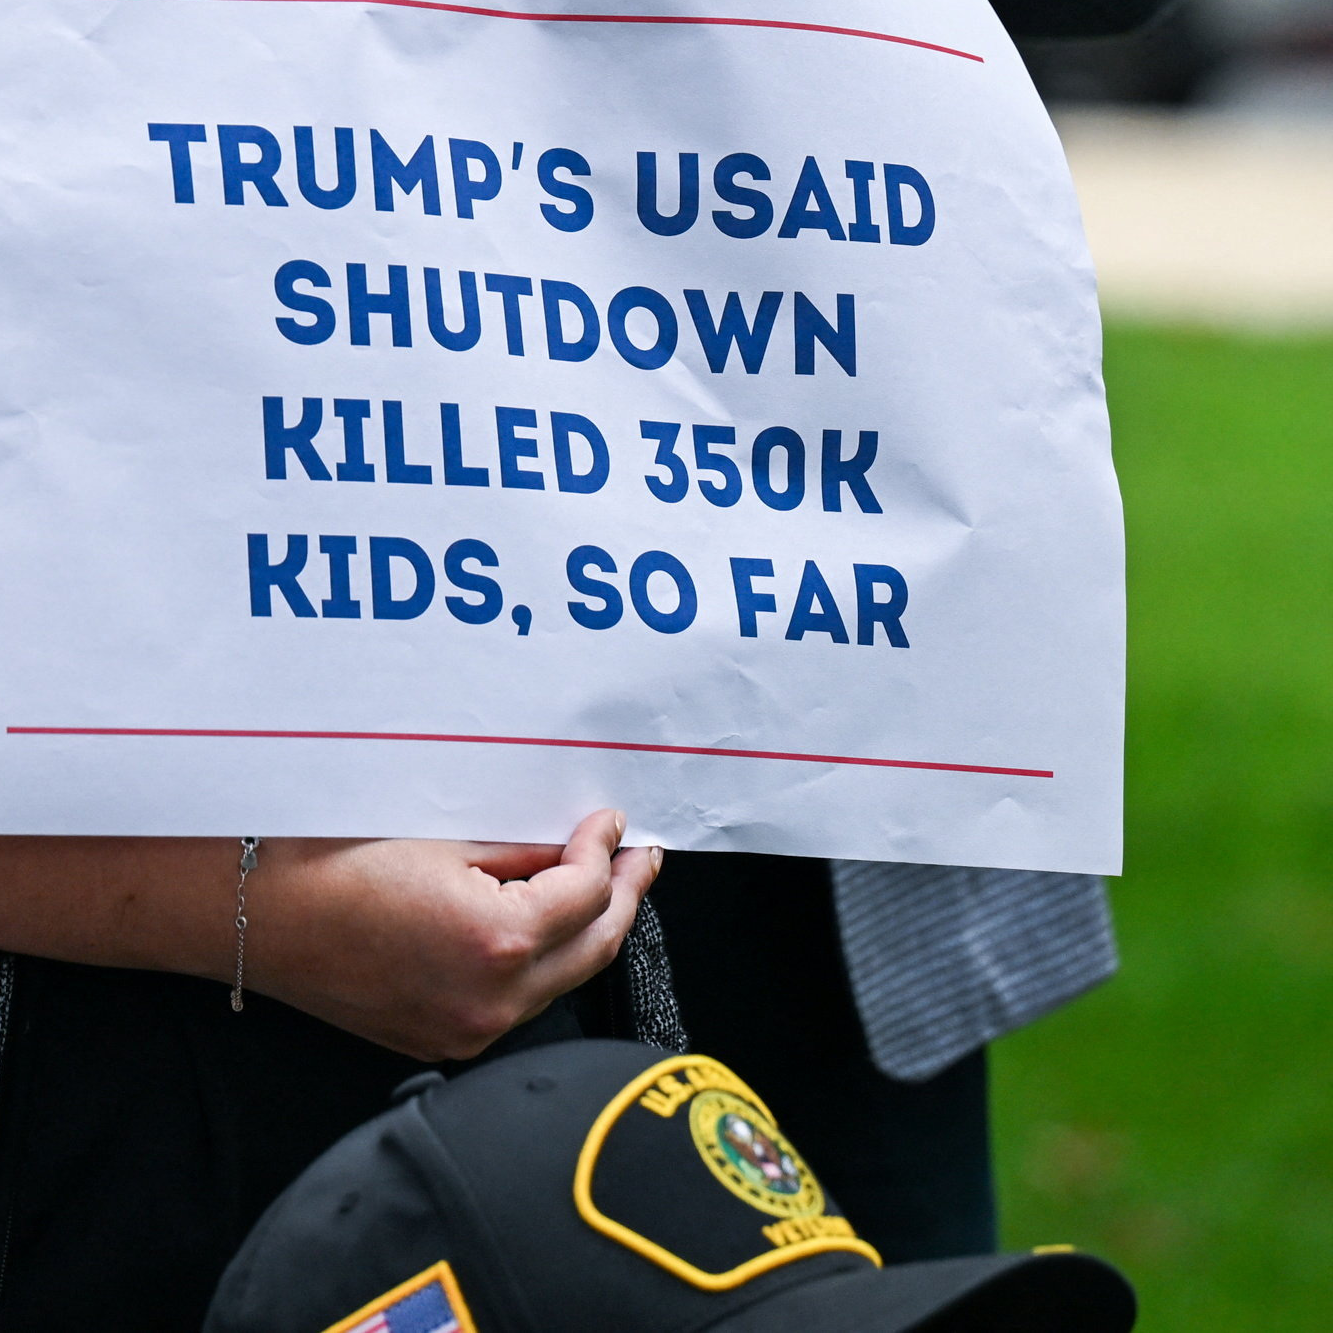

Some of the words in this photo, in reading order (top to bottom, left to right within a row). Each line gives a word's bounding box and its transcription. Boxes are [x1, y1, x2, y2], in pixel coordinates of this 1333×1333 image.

[147, 122, 594, 233] TRUMP'S
[636, 151, 936, 247] USAID
[273, 259, 858, 378] SHUTDOWN
[261, 396, 610, 495] KILLED
[639, 420, 884, 515] 350K
[247, 533, 533, 637] KIDS,
[566, 545, 698, 635] SO
[729, 557, 911, 649] FAR
